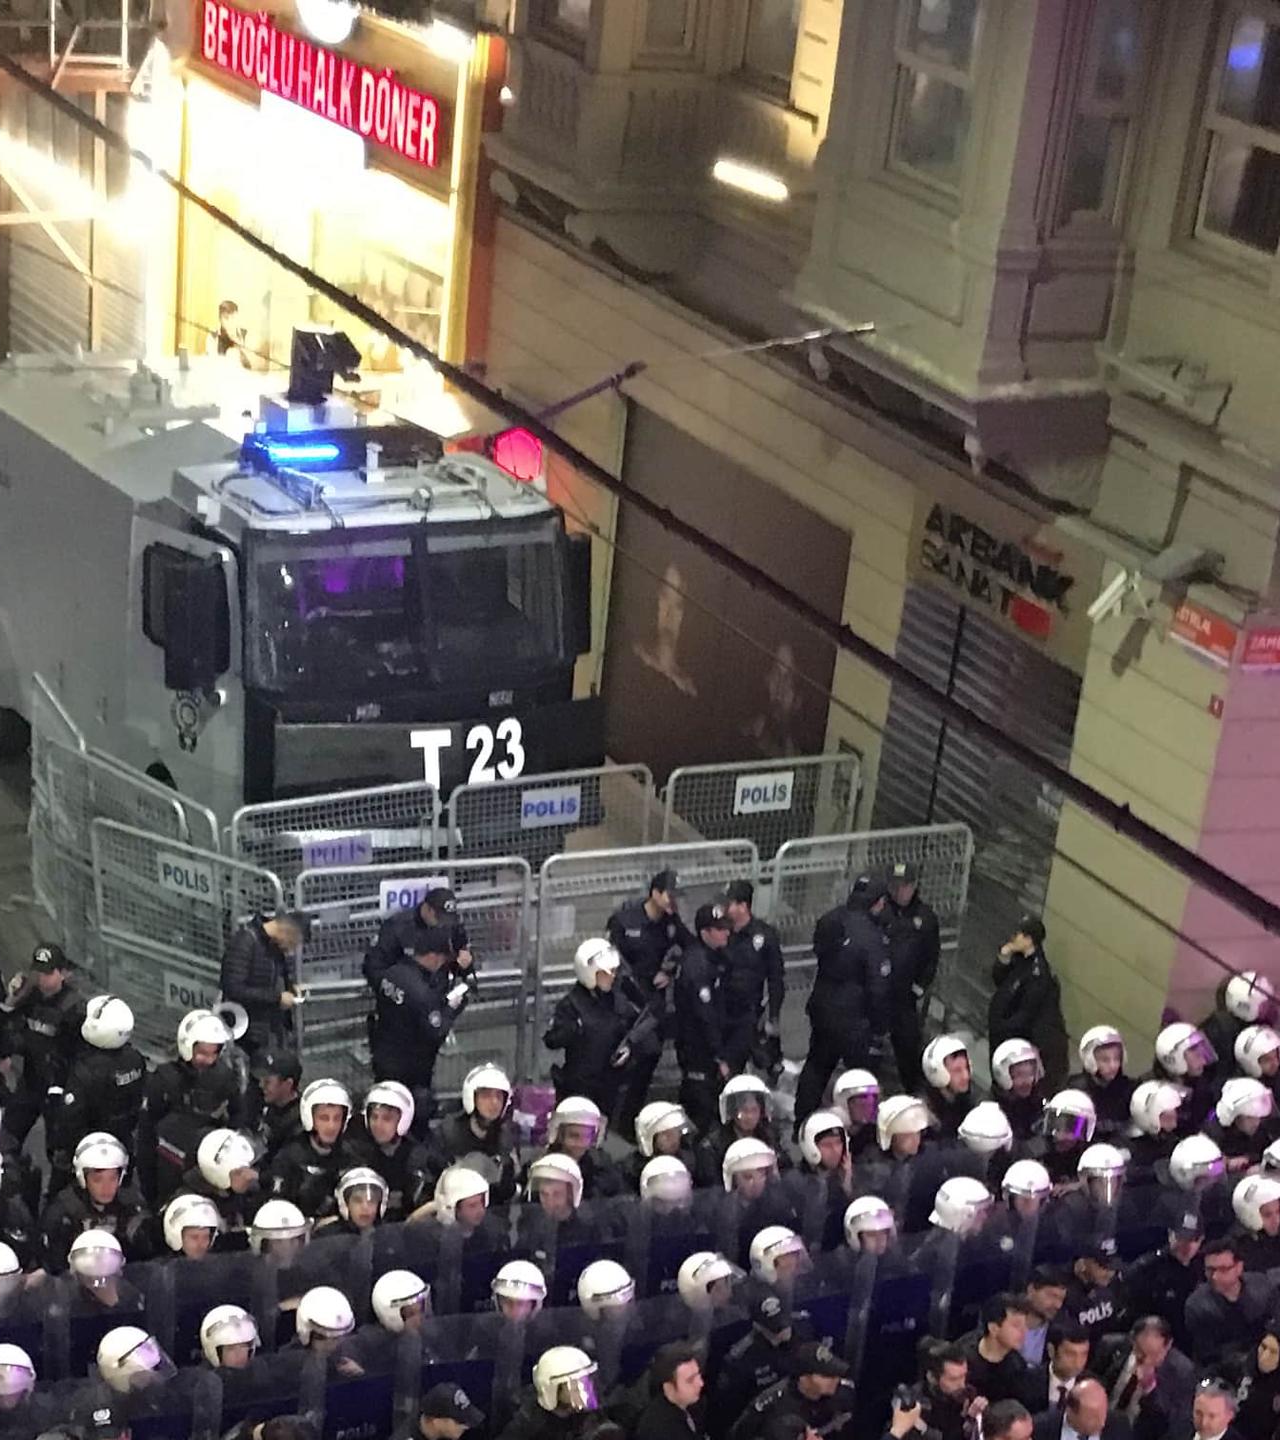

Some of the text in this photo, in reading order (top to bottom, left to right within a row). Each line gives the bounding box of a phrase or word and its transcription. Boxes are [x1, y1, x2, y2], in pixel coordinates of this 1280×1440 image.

[204, 0, 438, 168] BEYOĞLU HALK DÖNER
[924, 502, 1075, 602] AKBANK
[410, 716, 527, 790] T 23
[523, 796, 578, 819] POLİS
[740, 778, 789, 805] POLİS
[162, 860, 211, 894] POLİS
[1078, 1301, 1114, 1326] POLİS
